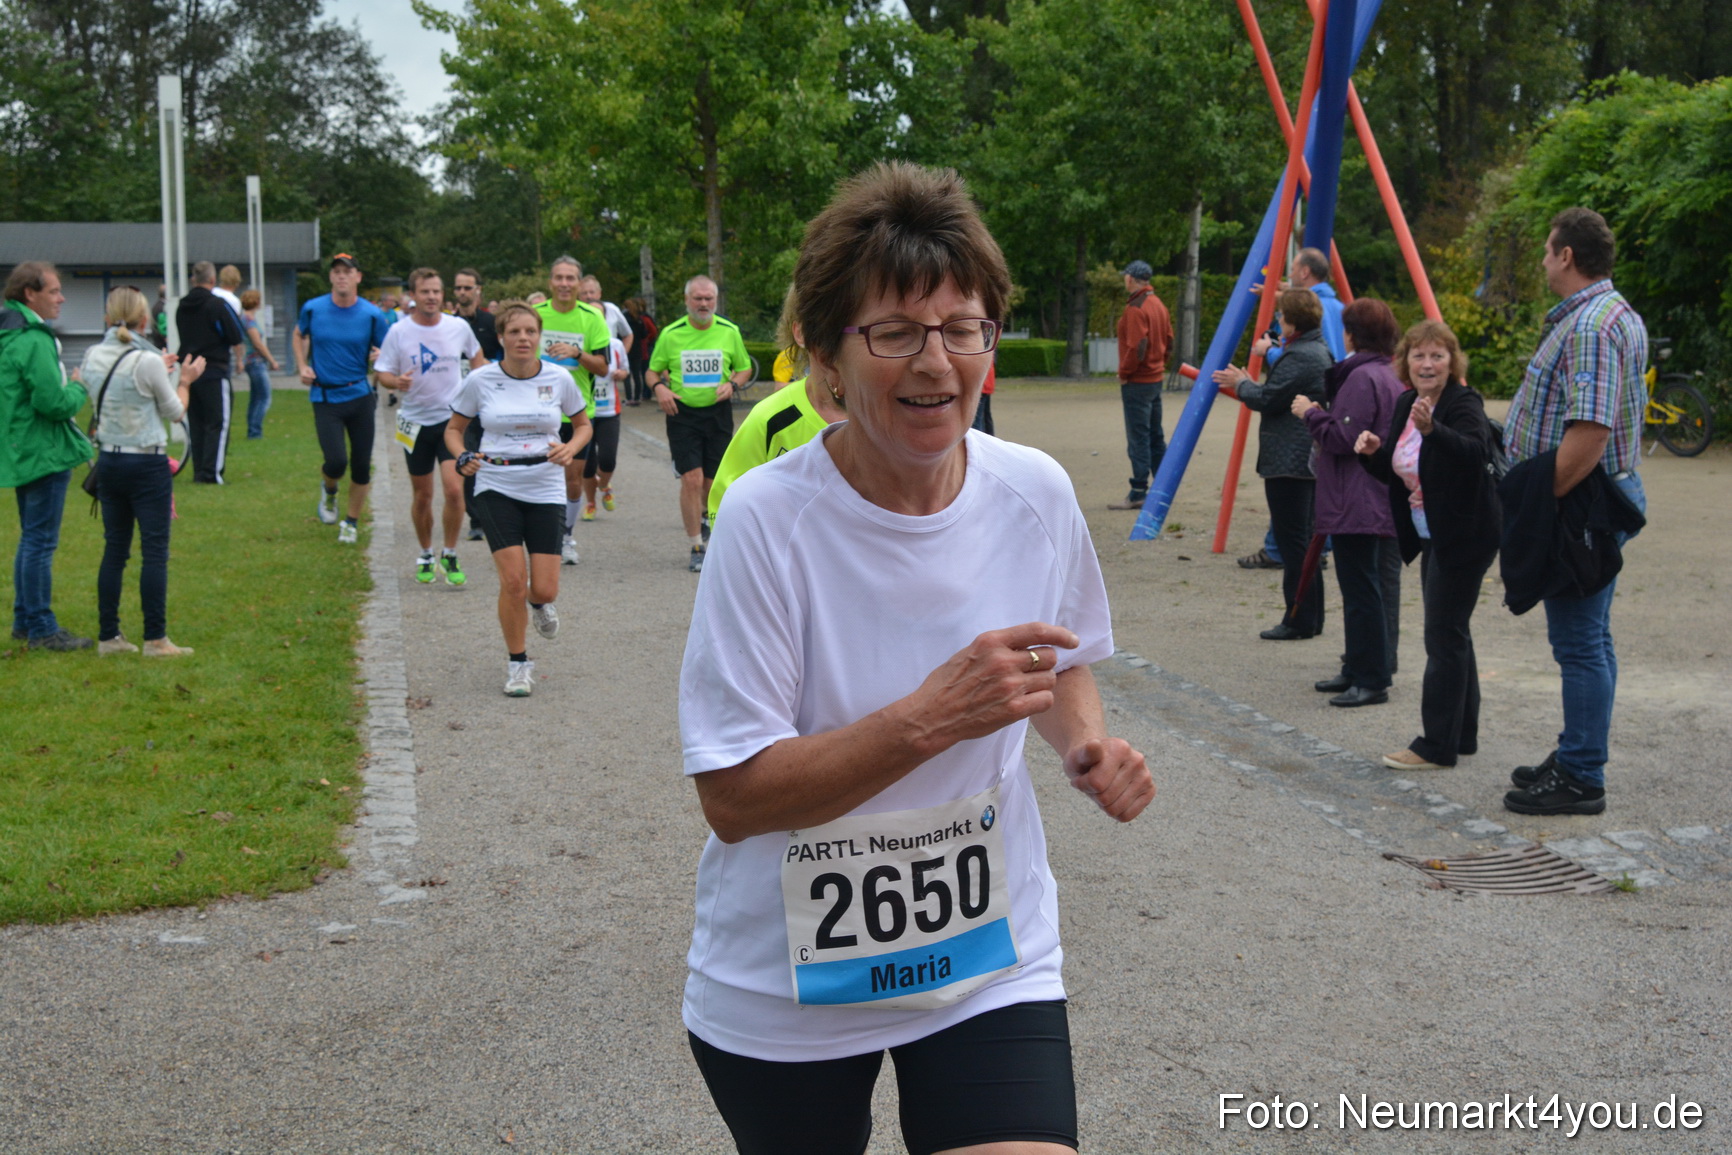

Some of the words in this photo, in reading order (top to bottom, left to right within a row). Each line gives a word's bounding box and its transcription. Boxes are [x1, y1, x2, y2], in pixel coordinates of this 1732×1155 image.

[685, 359, 719, 373] 3308
[787, 840, 863, 863] PARTL
[869, 818, 973, 854] Neumarkt
[810, 844, 990, 950] 2650
[870, 955, 951, 994] Maria
